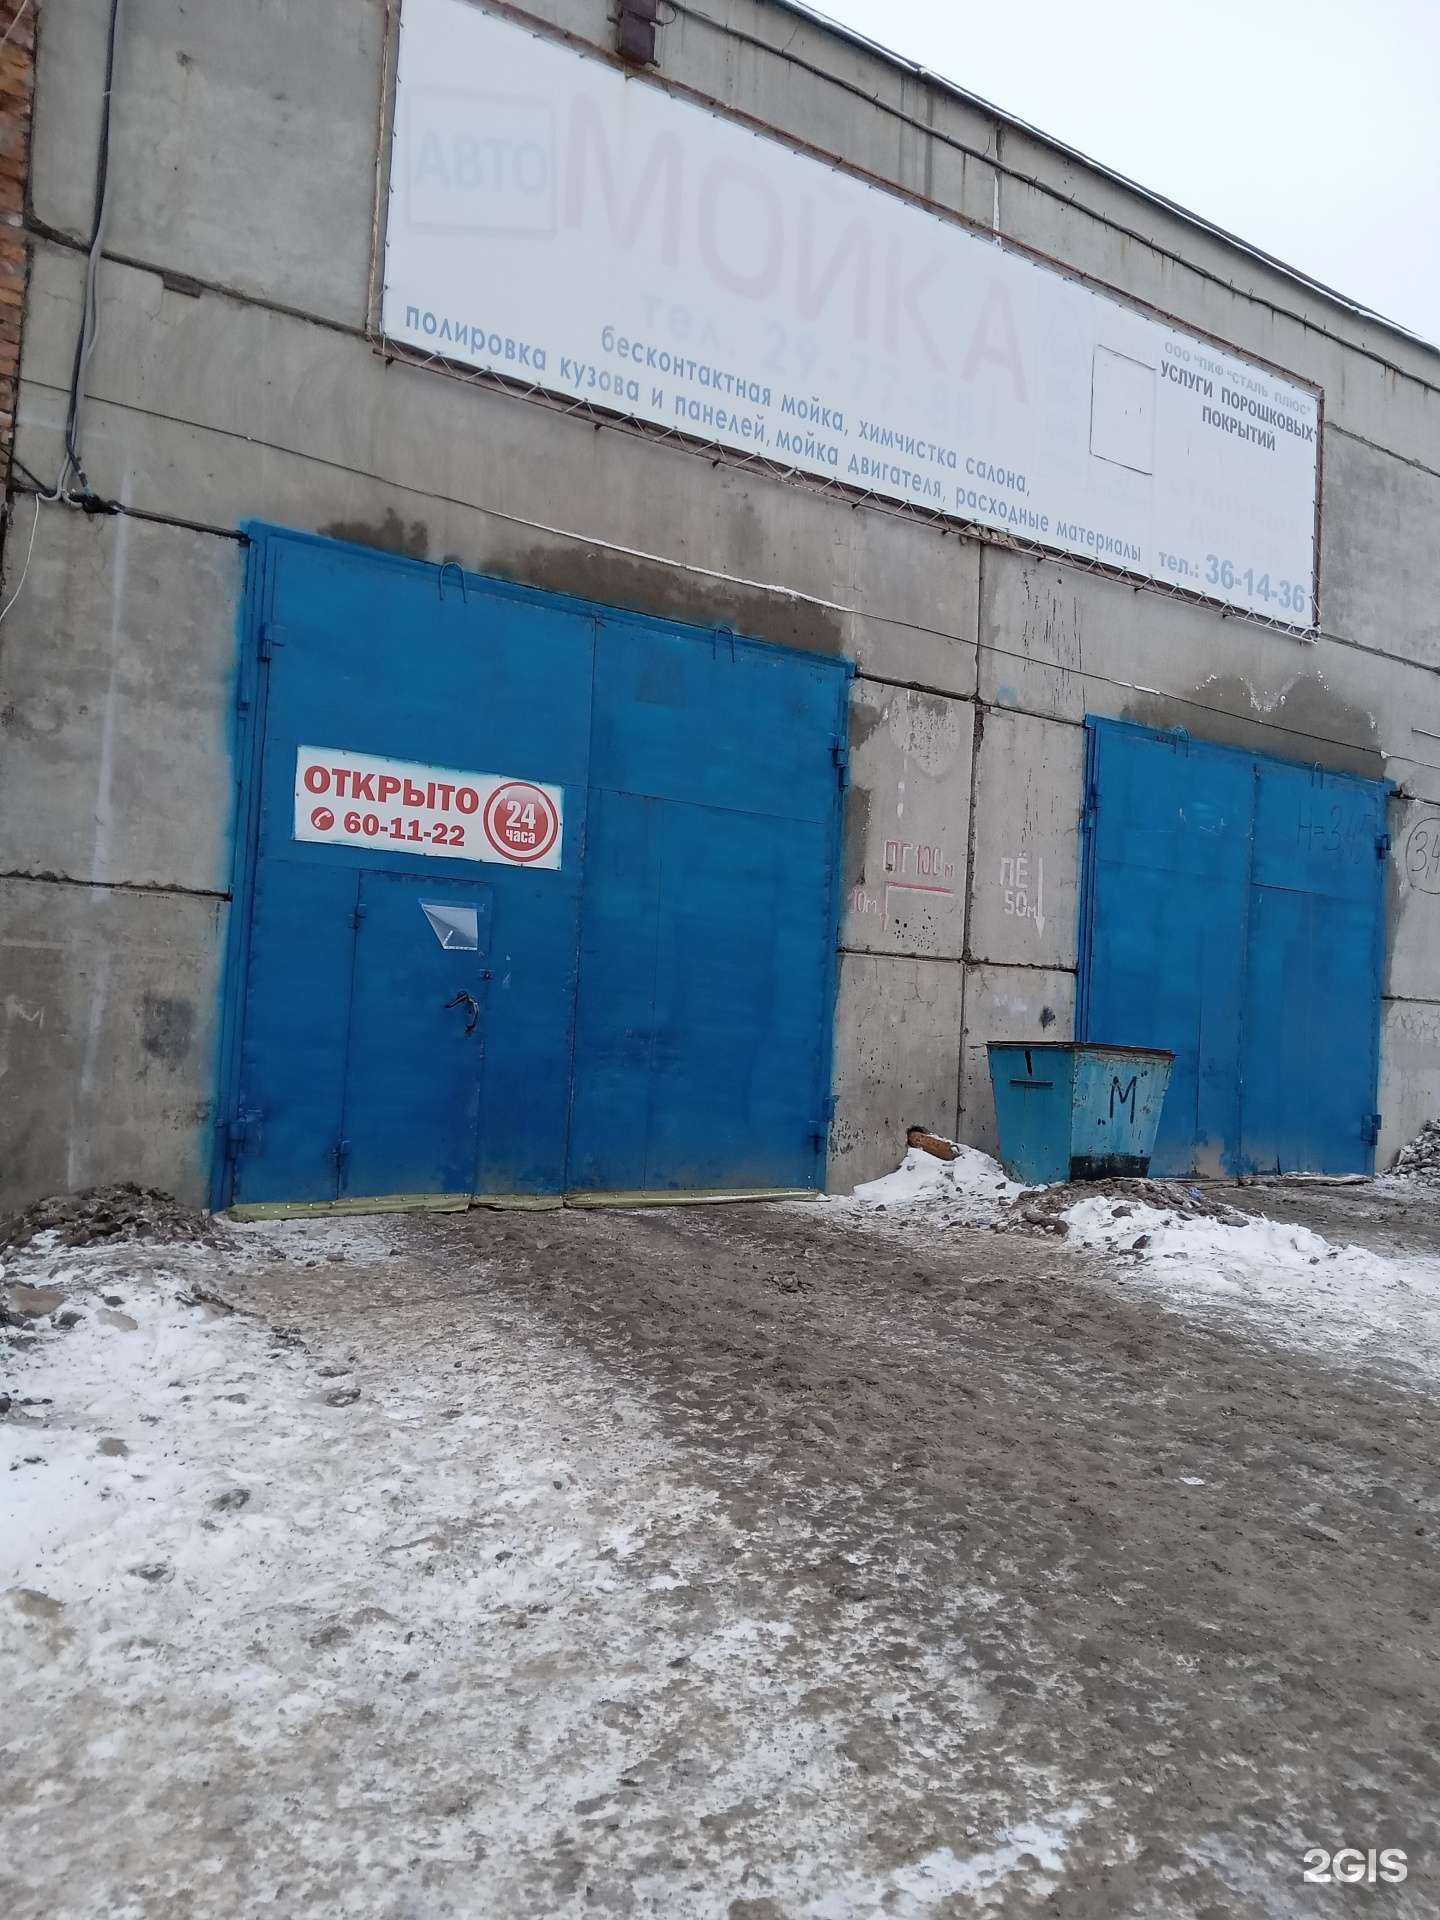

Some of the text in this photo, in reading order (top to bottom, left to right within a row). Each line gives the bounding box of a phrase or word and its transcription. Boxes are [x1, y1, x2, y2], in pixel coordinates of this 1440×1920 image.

[413, 128, 554, 195] АВТО
[562, 92, 1029, 404] МОЙКА
[1164, 341, 1190, 362] ООО
[601, 325, 1030, 497] бесконтактная мойка, химчистка салона,
[1160, 359, 1314, 443] УСЛУГИ ПОРОШКОВЫХ
[1202, 404, 1276, 451] ПОКРЫТИЙ
[405, 305, 546, 371] полировка
[560, 356, 640, 402] кузова
[651, 386, 663, 410] и
[675, 393, 770, 448] панелей,
[776, 429, 839, 467] мойка
[848, 453, 946, 504] двигателя,
[956, 485, 1049, 533] расходные
[1057, 520, 1141, 562] материалы
[1205, 554, 1305, 613] 36-14-36
[304, 765, 479, 815] ОТКРЫТО
[506, 800, 536, 829] 24
[343, 811, 466, 847] 60-11-22
[505, 828, 536, 845] часа
